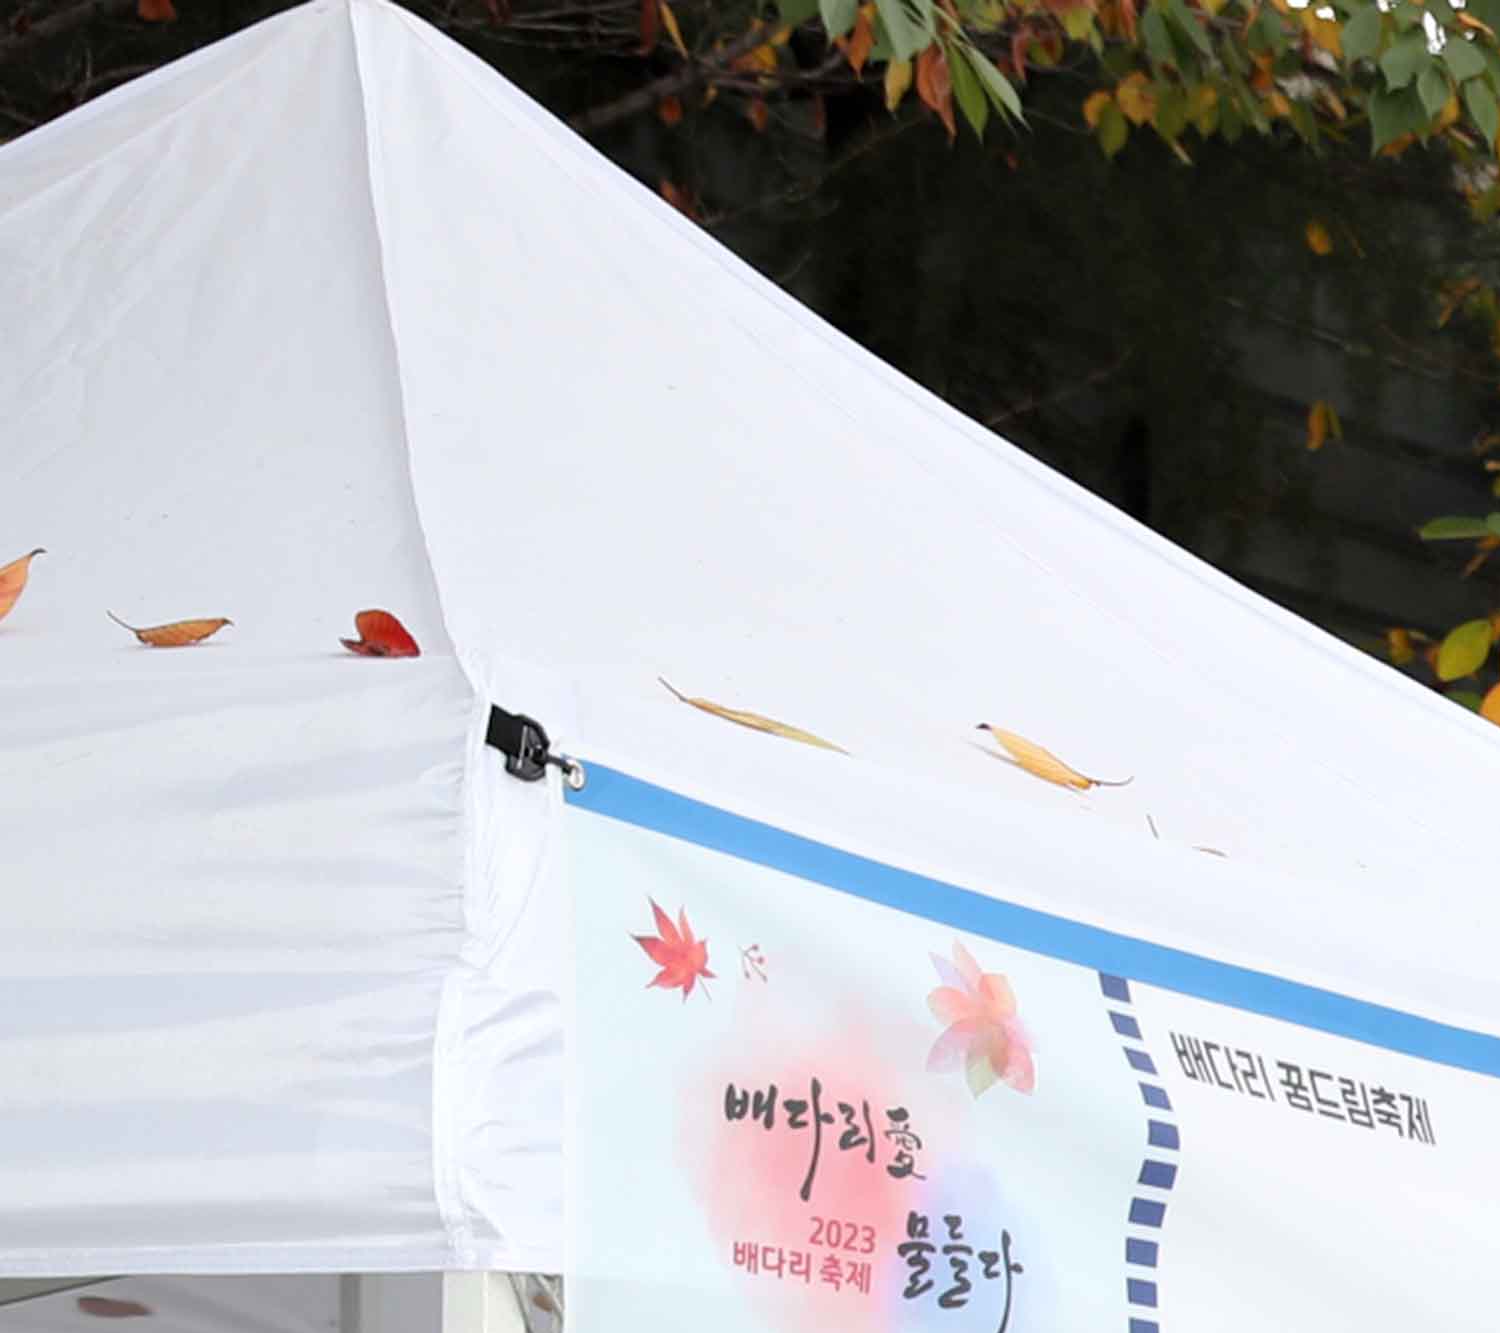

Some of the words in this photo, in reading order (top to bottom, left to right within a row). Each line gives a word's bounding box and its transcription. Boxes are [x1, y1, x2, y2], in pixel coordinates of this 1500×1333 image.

[1171, 1031, 1273, 1103] 배다리
[1279, 1059, 1437, 1146] 꿈드림축제
[808, 1217, 876, 1254] 2023
[732, 1242, 812, 1285] 배다리
[818, 1254, 873, 1295] 축제
